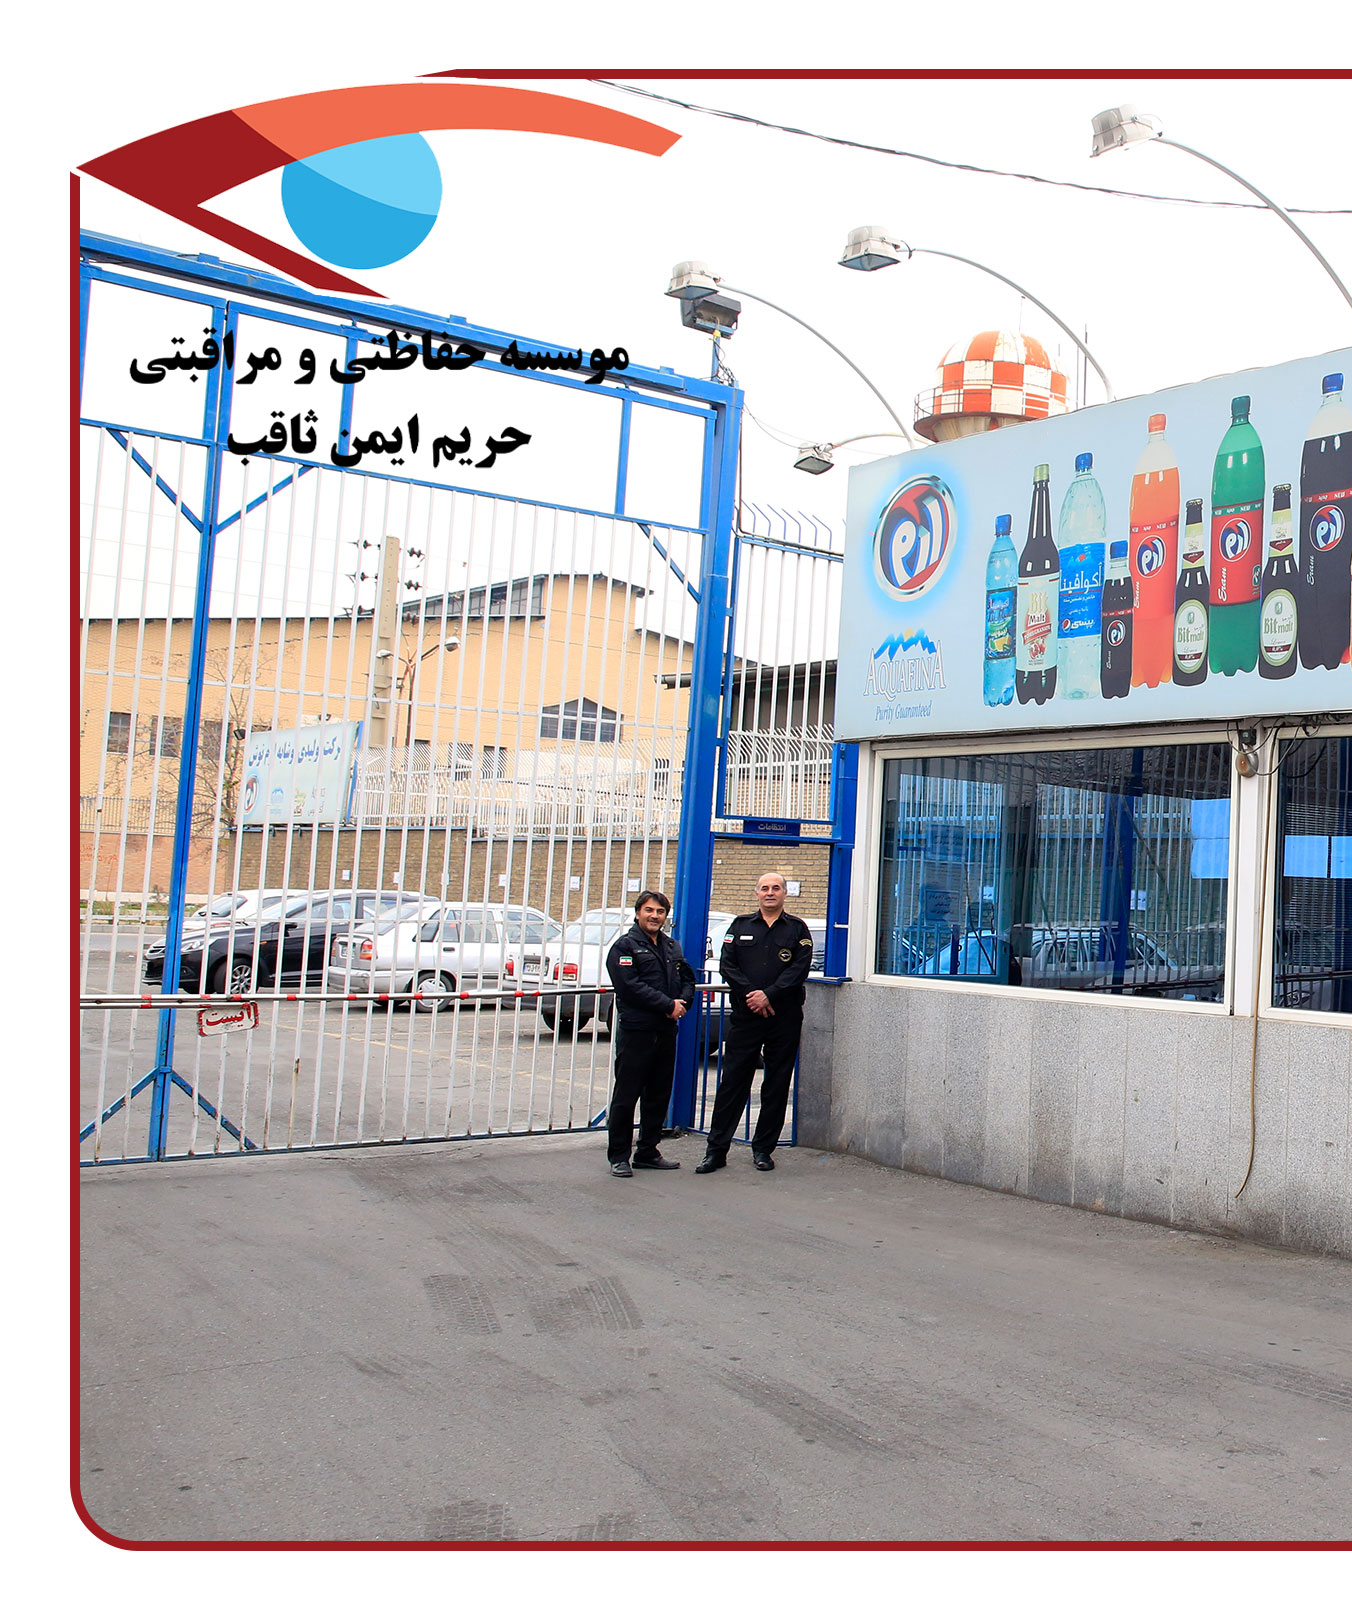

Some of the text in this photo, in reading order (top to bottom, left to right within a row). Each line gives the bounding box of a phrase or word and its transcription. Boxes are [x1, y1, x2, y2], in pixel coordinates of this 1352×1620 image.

[863, 640, 947, 702] AQUAFINA
[875, 699, 932, 723] Purity Guaranteed
[758, 823, 787, 832] انتظامات
[206, 1004, 252, 1028] ایست
